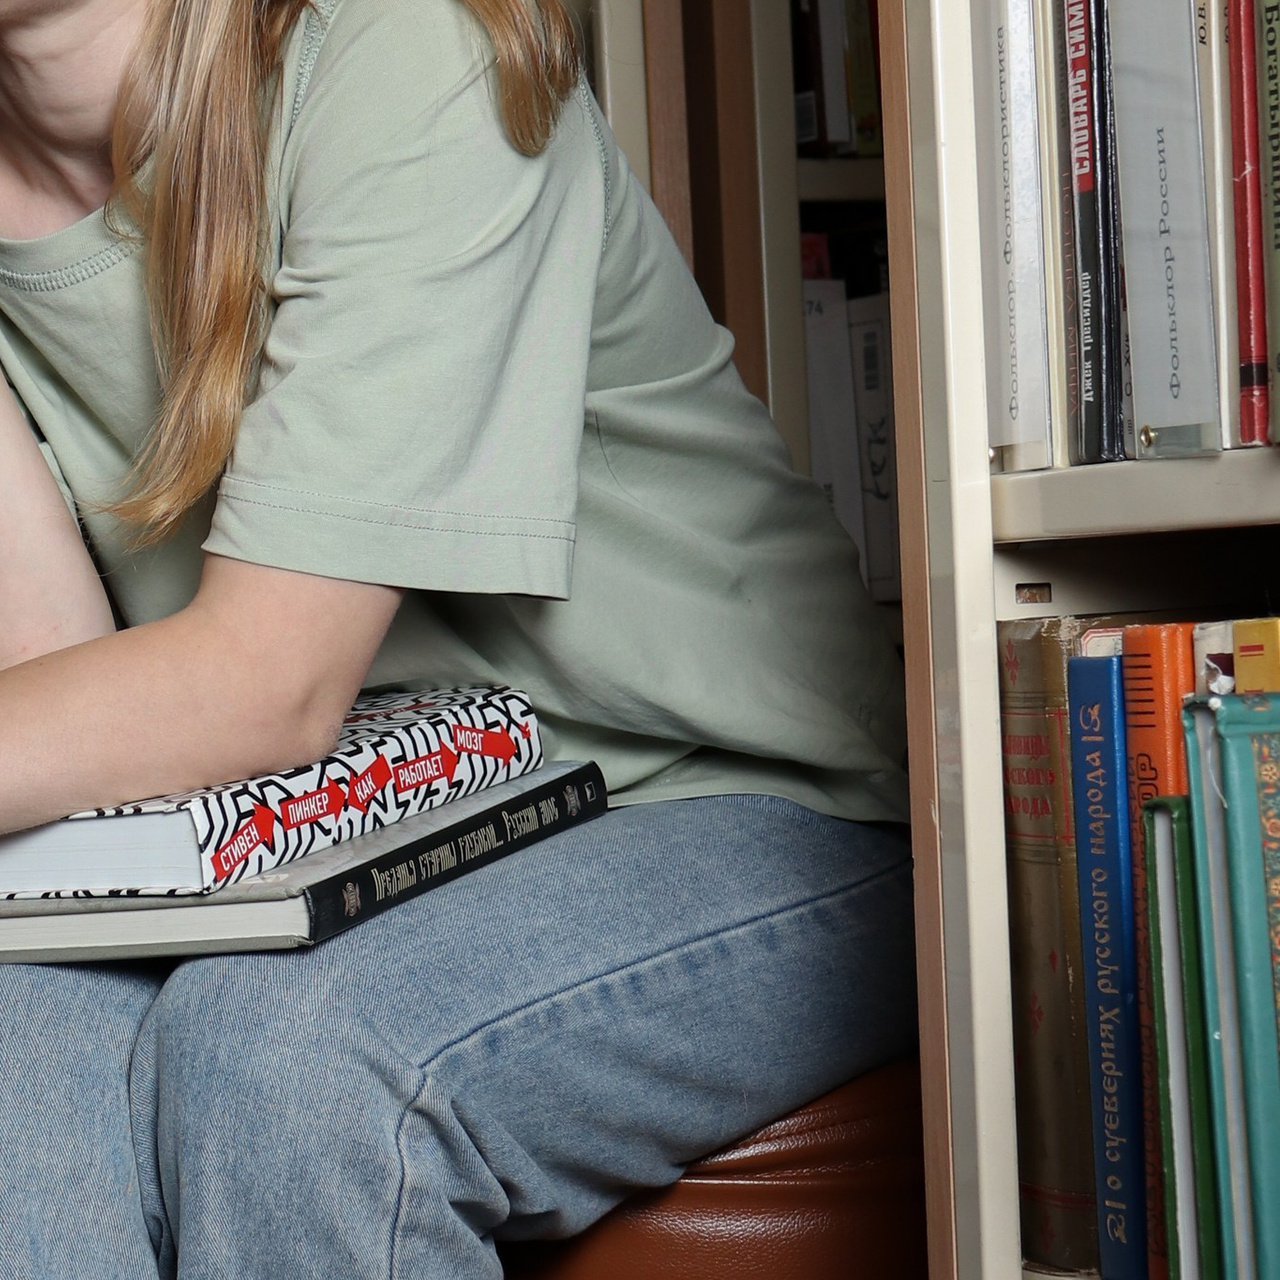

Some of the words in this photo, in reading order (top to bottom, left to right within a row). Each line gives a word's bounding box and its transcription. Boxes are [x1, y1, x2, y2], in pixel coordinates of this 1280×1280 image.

[994, 26, 1015, 265] Фольклористика
[1068, 69, 1092, 175] СЛОВАРЬ
[1154, 128, 1171, 234] России
[1001, 271, 1020, 420] Фольклор.
[1162, 247, 1184, 399] Фольклор
[219, 826, 260, 872] СТИВЕН
[288, 793, 329, 825] ПИНКЕР
[354, 777, 377, 803] КАК
[398, 756, 444, 788] РАБОТАЕТ
[456, 730, 484, 751] МОЗГ
[1083, 751, 1106, 852] народа
[1109, 1175, 1120, 1190] о
